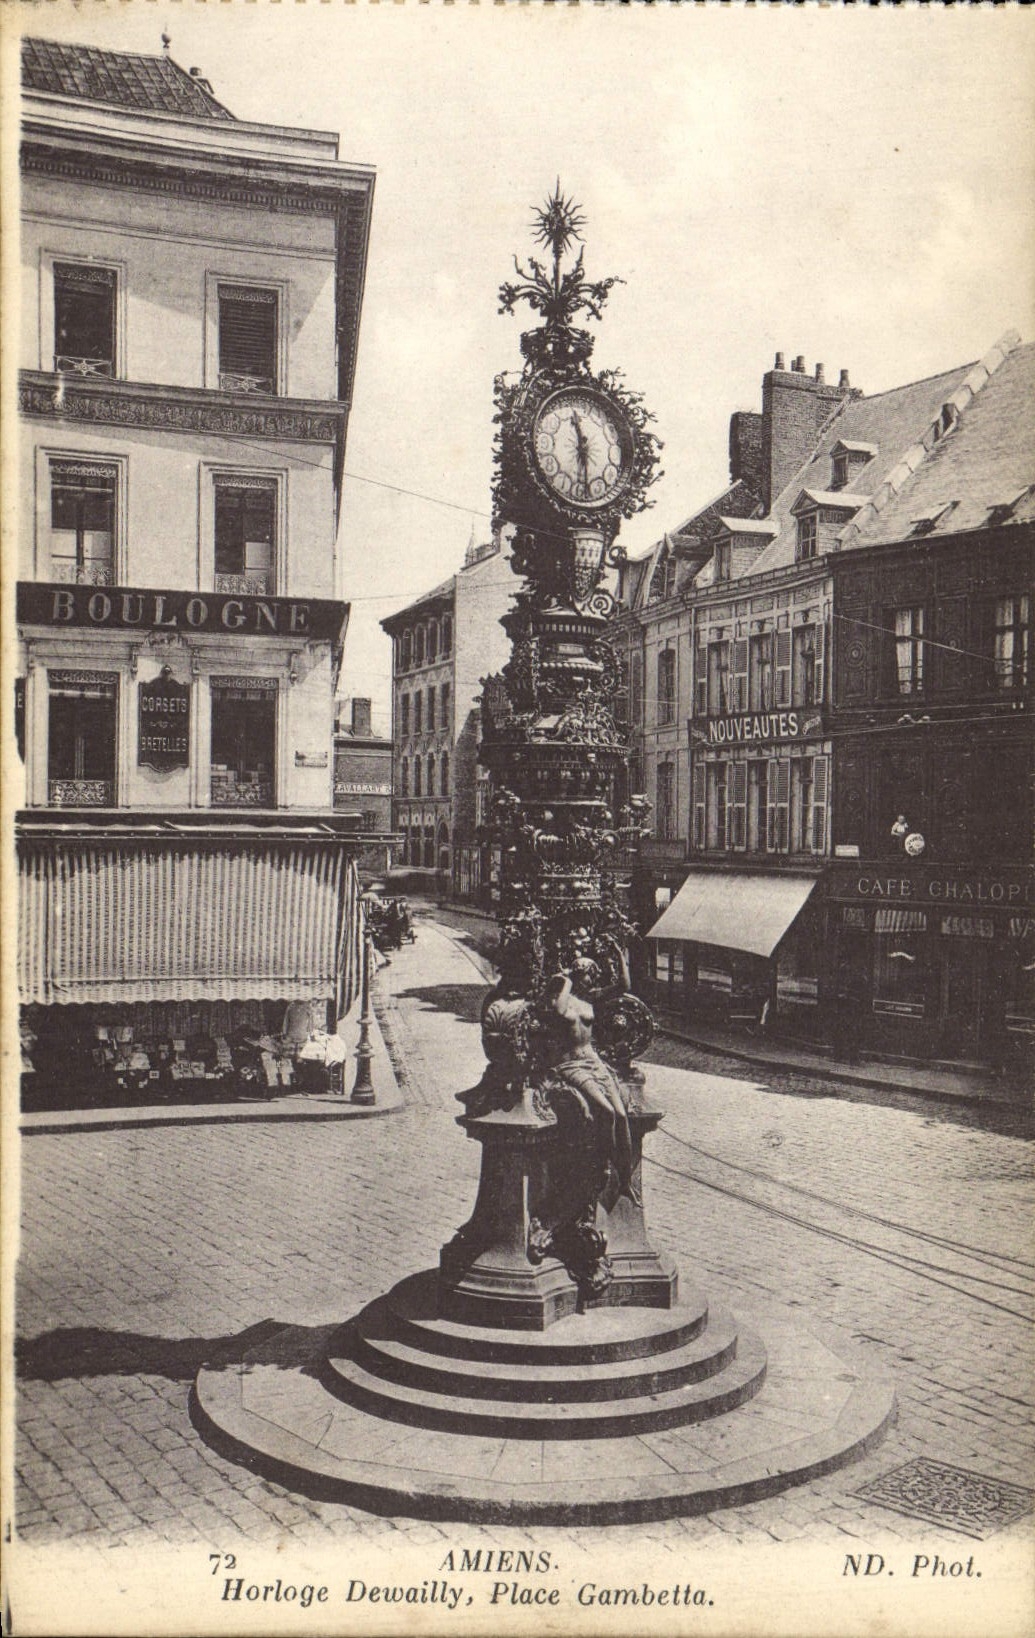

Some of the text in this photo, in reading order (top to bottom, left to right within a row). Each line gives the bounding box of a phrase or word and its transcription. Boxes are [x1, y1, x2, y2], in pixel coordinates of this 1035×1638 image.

[52, 590, 311, 632] BOULOGNE
[141, 696, 187, 713] CORSETS
[709, 713, 799, 743] NOUVEAUTES
[141, 736, 188, 752] BRETELLES
